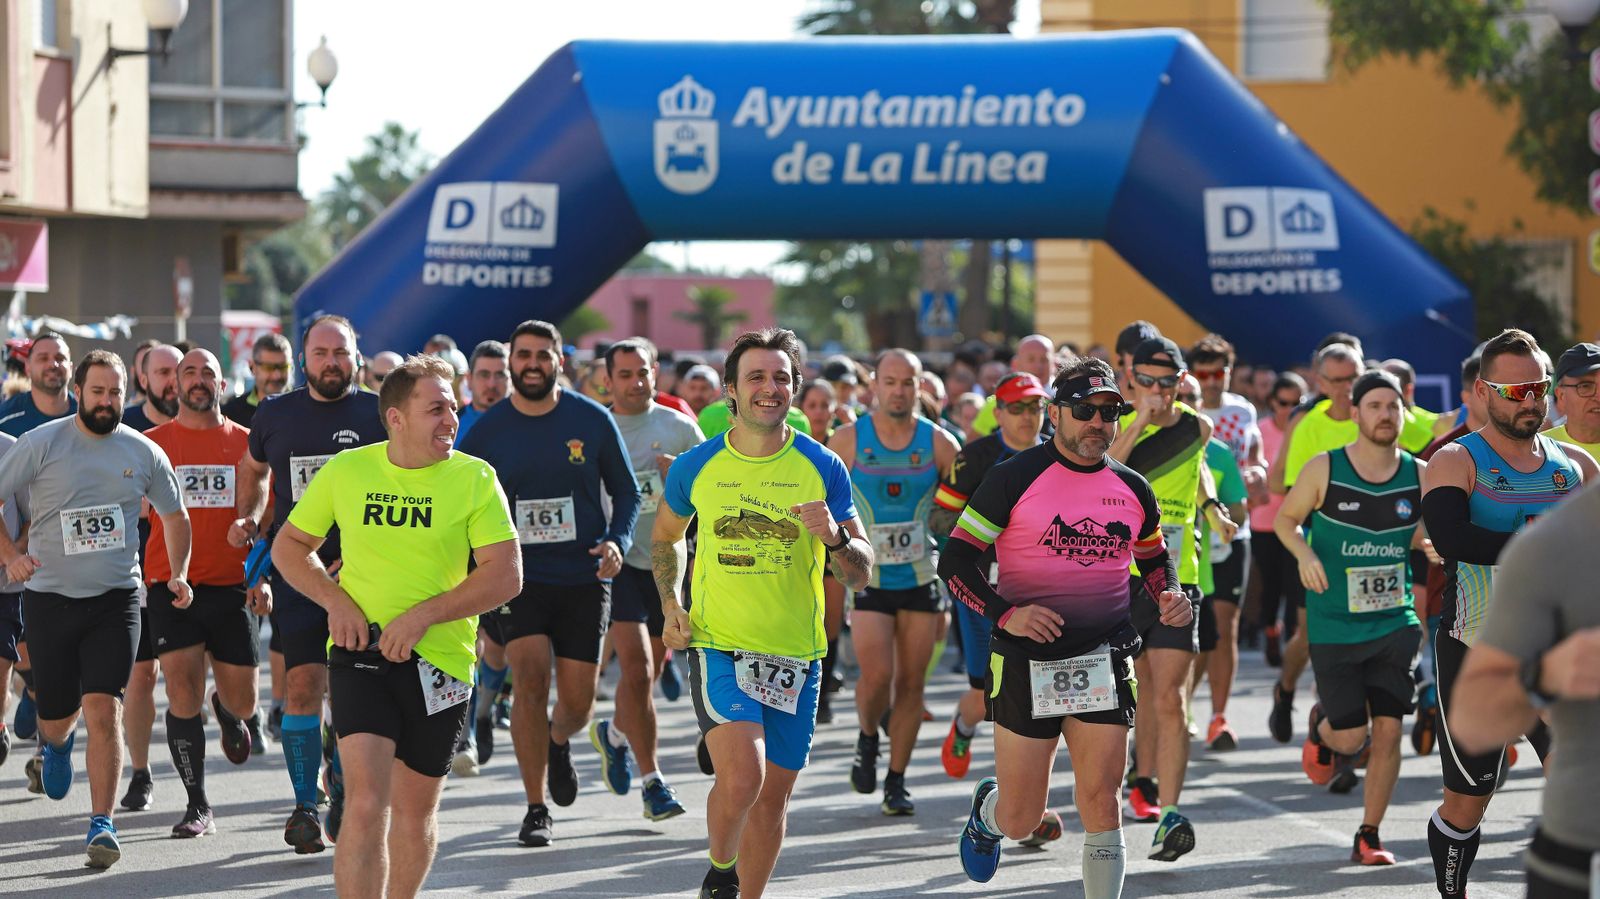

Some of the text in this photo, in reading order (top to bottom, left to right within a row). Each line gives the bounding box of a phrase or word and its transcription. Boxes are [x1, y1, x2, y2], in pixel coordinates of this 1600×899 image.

[732, 84, 1086, 139] Ayuntamiento
[771, 140, 1048, 184] de La Línea
[445, 198, 476, 230] D
[1223, 204, 1255, 239] D
[422, 262, 552, 287] DEPORTES
[1210, 268, 1342, 295] DEPORTES
[185, 475, 226, 491] 218
[365, 492, 432, 505] KEEP YOUR
[72, 516, 115, 536] 139
[363, 503, 432, 528] RUN
[526, 508, 563, 526] 161
[887, 533, 911, 549] 10
[1048, 547, 1120, 559] TRAIL
[1341, 540, 1406, 558] Ladbroke
[1359, 576, 1398, 594] 182
[748, 661, 796, 689] 173
[1053, 669, 1090, 692] 83
[1445, 844, 1459, 892] COMPRESPORT
